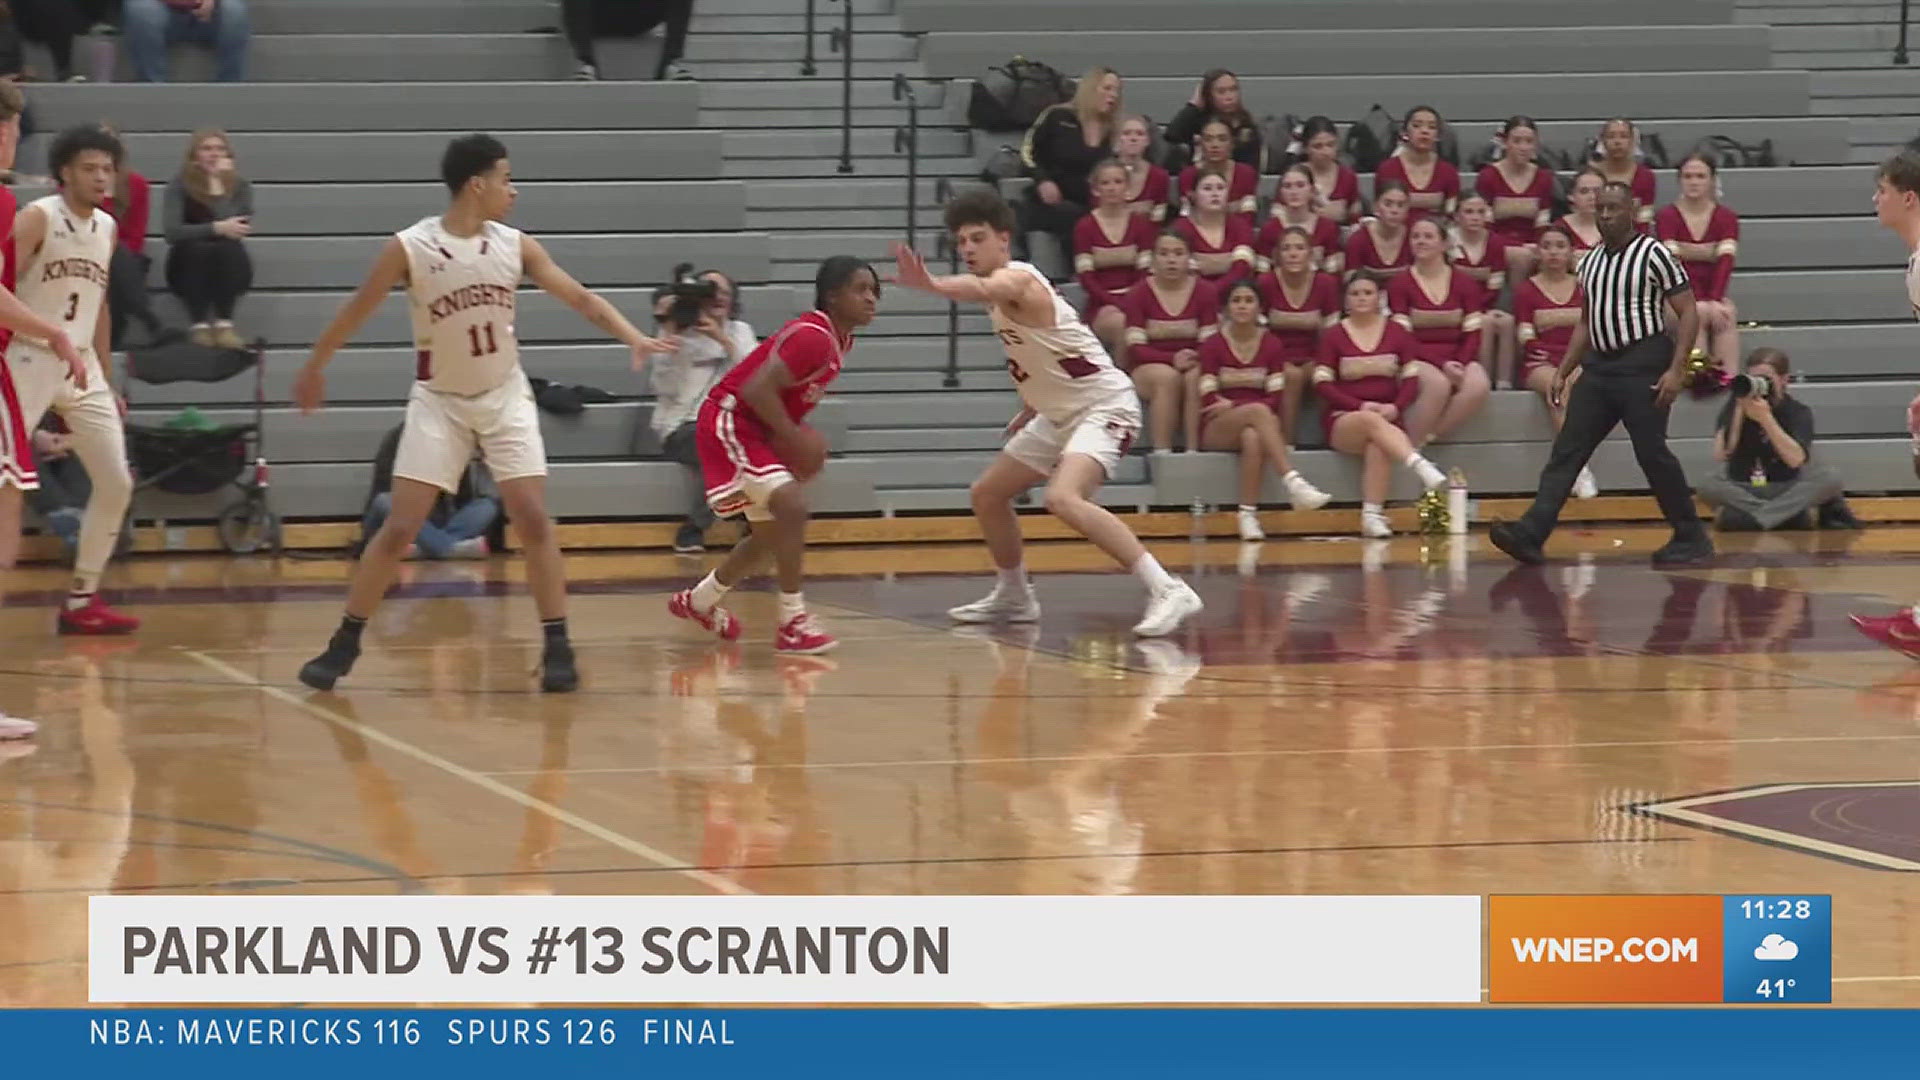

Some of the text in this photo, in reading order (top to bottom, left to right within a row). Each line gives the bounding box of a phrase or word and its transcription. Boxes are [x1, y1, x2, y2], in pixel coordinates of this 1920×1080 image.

[64, 292, 79, 321] 3
[427, 283, 512, 324] KNIGHTS
[467, 320, 498, 357] 11
